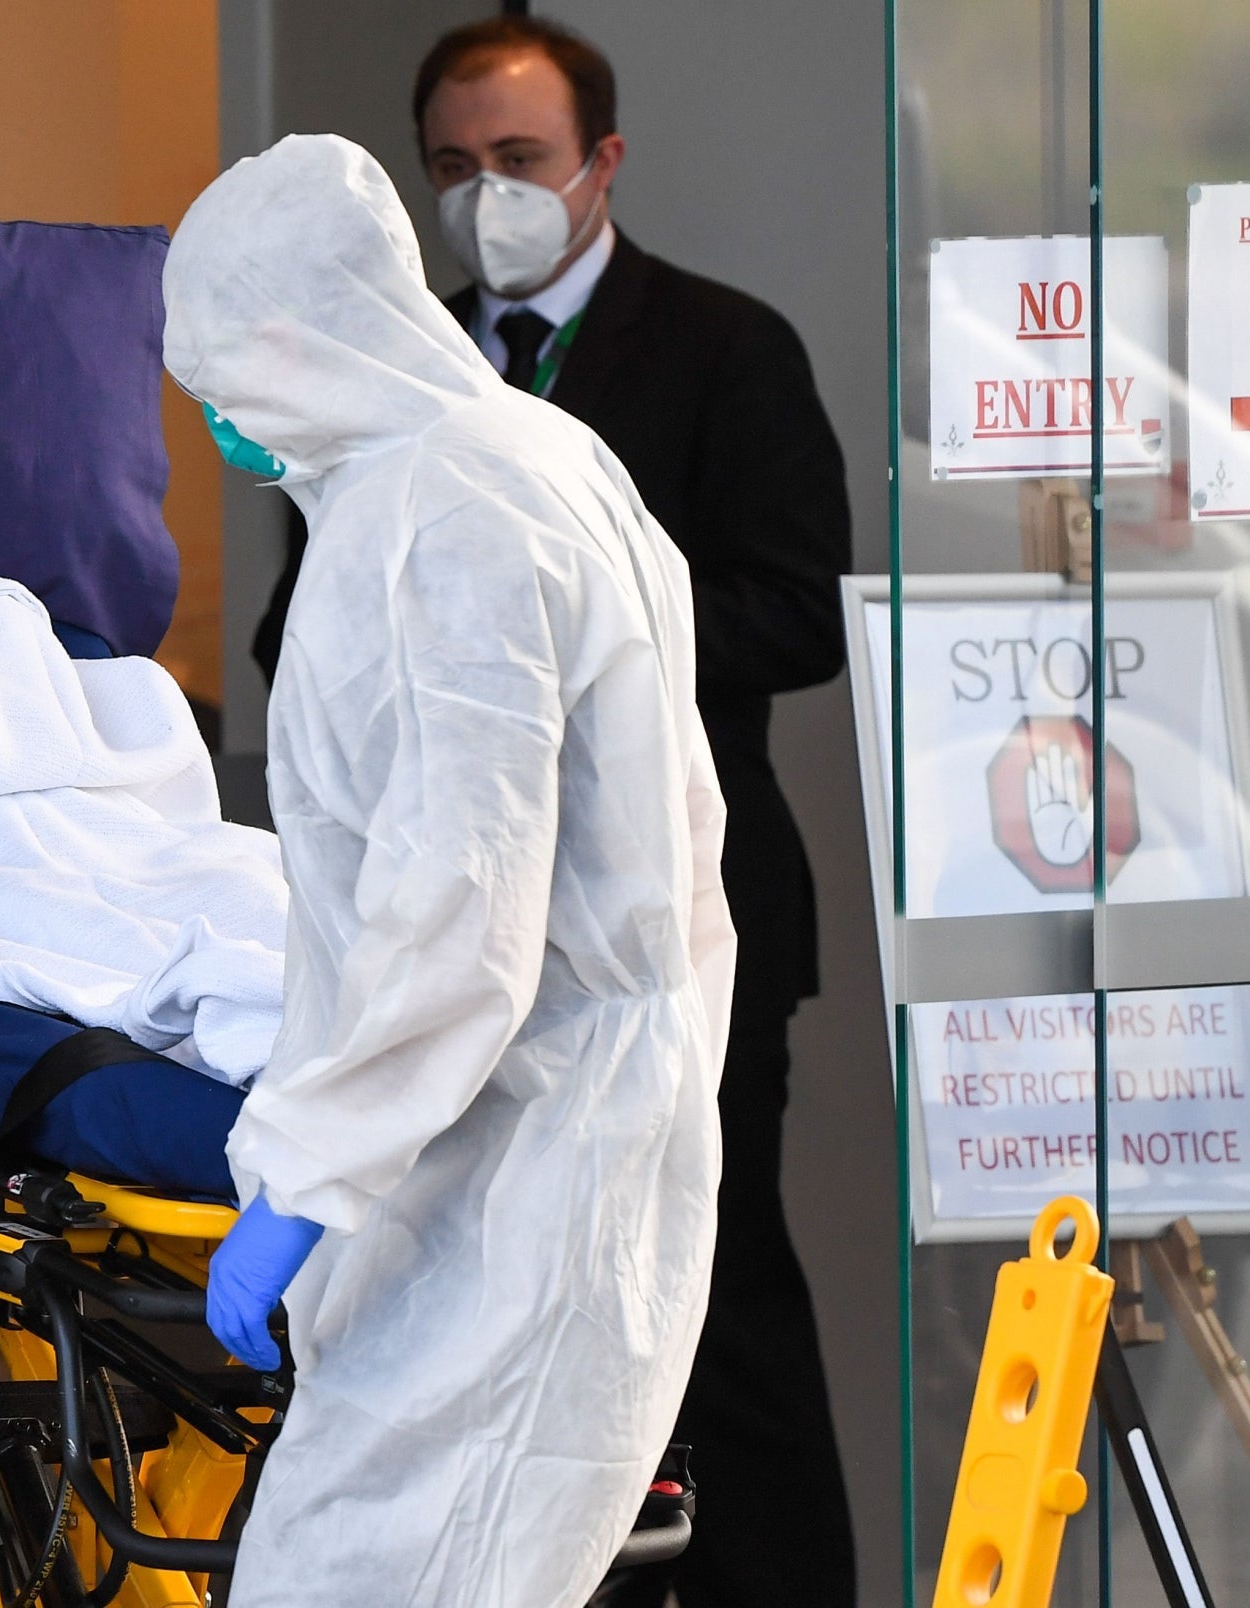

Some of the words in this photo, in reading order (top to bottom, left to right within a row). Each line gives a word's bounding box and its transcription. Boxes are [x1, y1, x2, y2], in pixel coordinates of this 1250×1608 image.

[1018, 281, 1083, 331] NO
[974, 376, 1135, 430] ENTRY
[949, 636, 1145, 703] STOP
[943, 1009, 998, 1043] ALL
[1005, 1003, 1156, 1040] VISITORS
[1167, 1002, 1228, 1036] ARE
[1148, 1066, 1245, 1101] UNTIL
[1121, 1130, 1241, 1165] NOTICE
[41, 1560, 54, 1580] WP
